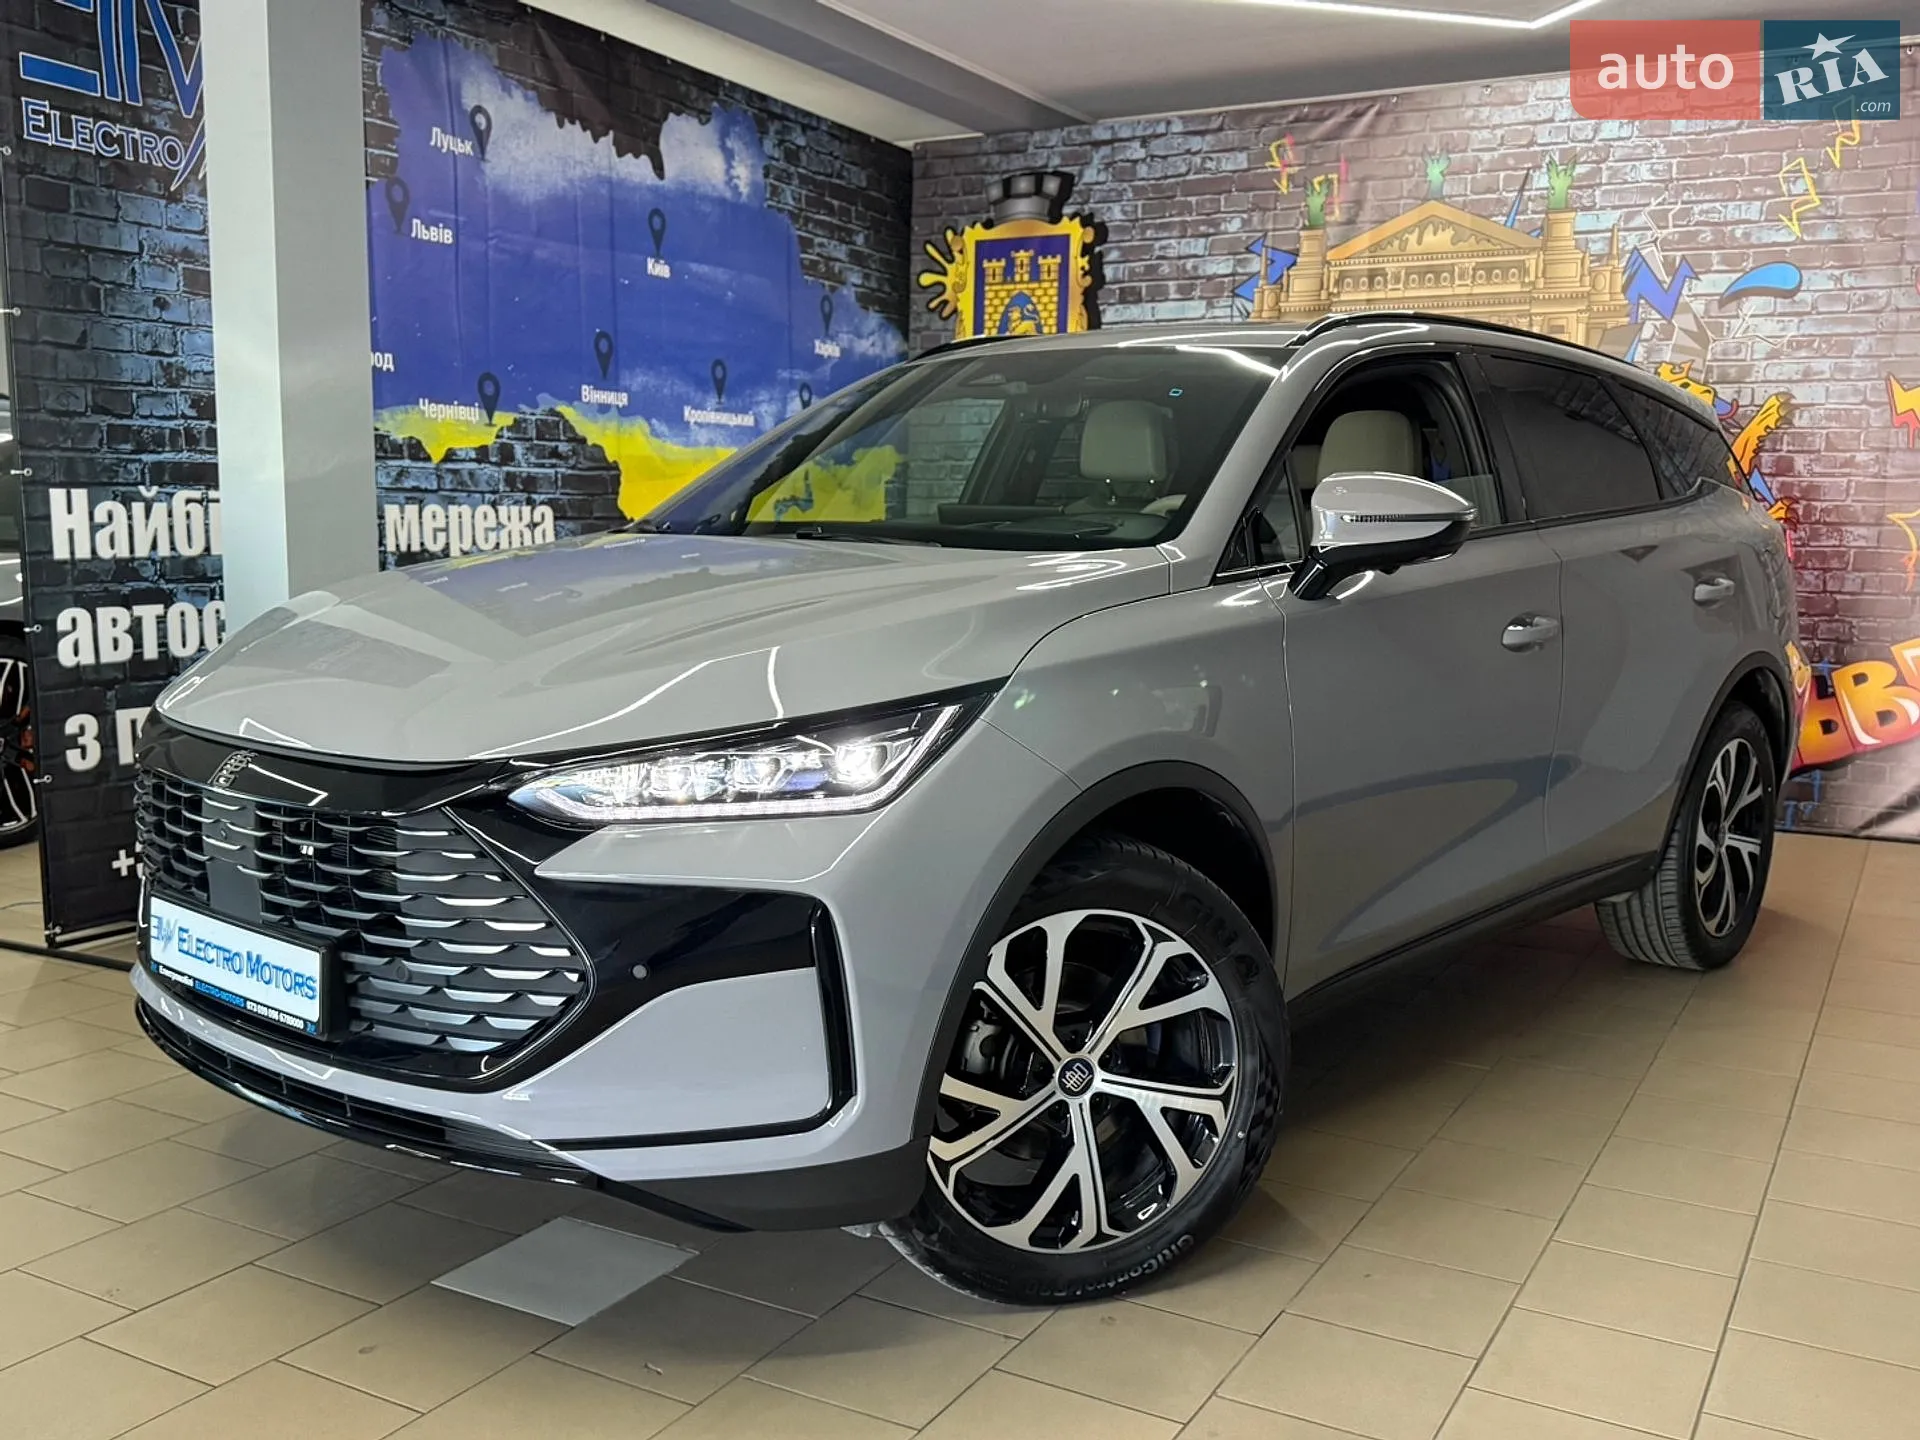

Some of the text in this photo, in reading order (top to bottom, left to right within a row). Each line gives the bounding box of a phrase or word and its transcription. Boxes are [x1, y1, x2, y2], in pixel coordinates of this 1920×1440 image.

[429, 126, 474, 156] Луцьк
[411, 218, 454, 244] Львів
[646, 256, 671, 279] Київ
[581, 384, 629, 408] Вінниця
[419, 398, 480, 423] Чернівці
[384, 503, 556, 557] мережа
